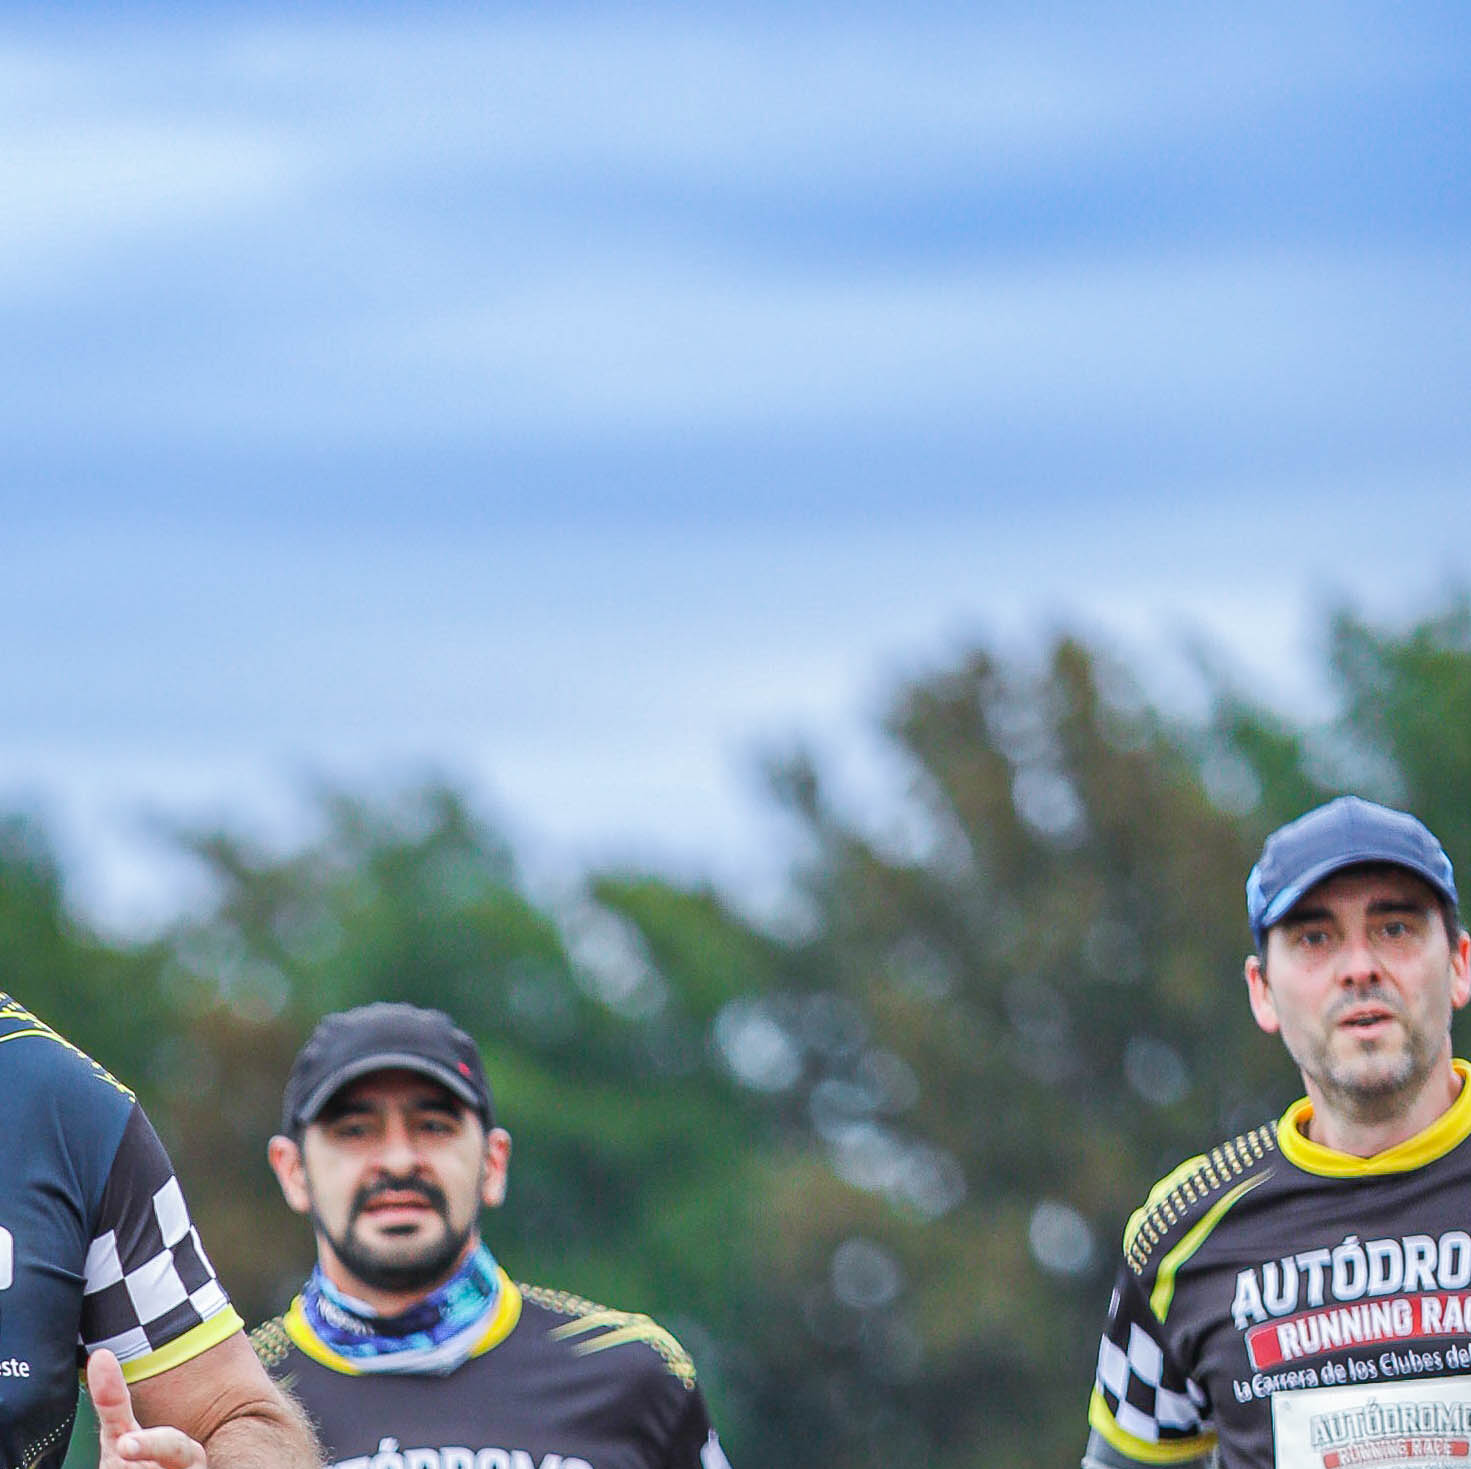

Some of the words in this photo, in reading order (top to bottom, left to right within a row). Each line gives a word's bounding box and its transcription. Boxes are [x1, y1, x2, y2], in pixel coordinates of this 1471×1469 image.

[1276, 1298, 1413, 1361] RUNNING
[1320, 1360, 1348, 1385] de
[1348, 1357, 1379, 1381] los
[1379, 1350, 1445, 1377] Clubes
